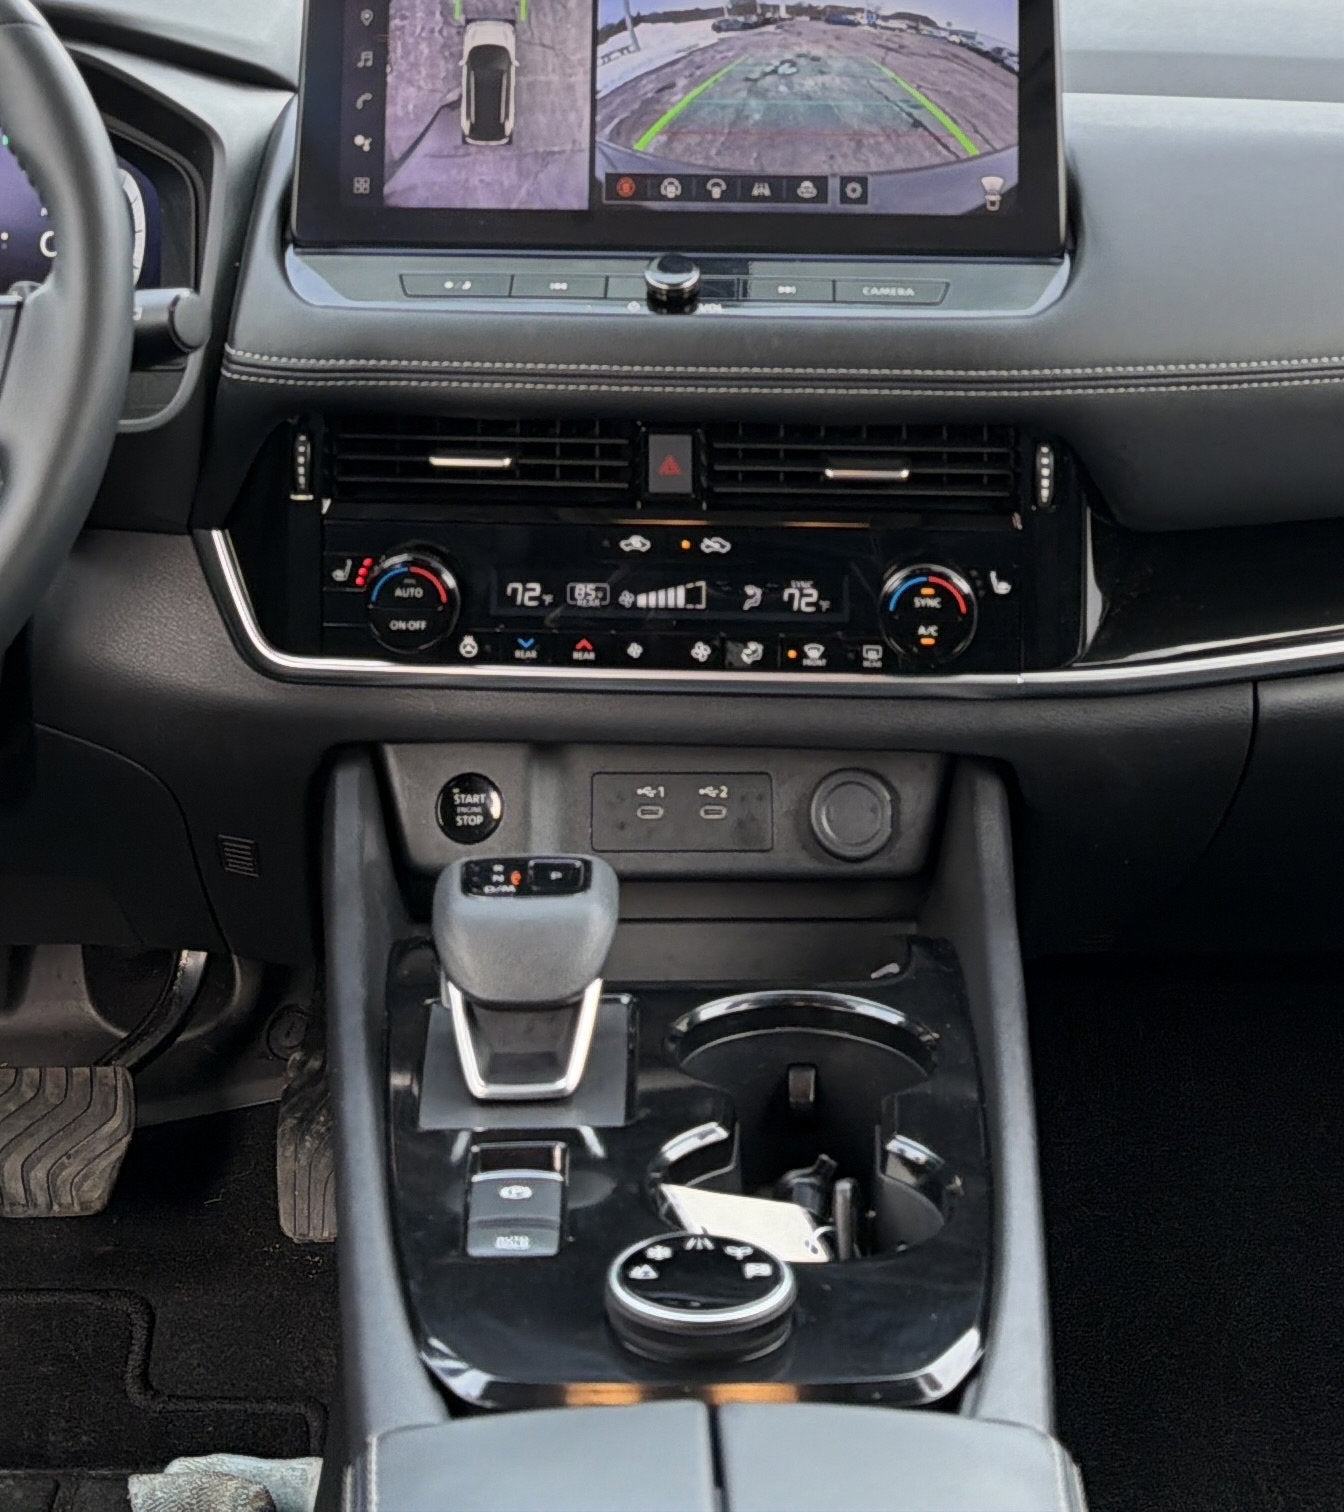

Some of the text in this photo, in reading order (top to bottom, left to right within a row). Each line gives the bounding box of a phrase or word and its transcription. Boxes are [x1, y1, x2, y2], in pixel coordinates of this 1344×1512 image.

[862, 286, 915, 297] CAMERA
[394, 587, 424, 599] AUTO
[913, 597, 942, 609] SYNC
[917, 625, 939, 637] A/C
[514, 649, 538, 659] REAR
[572, 651, 596, 660] REAR
[719, 785, 728, 798] 2
[453, 793, 486, 805] START
[455, 815, 484, 827] STOP
